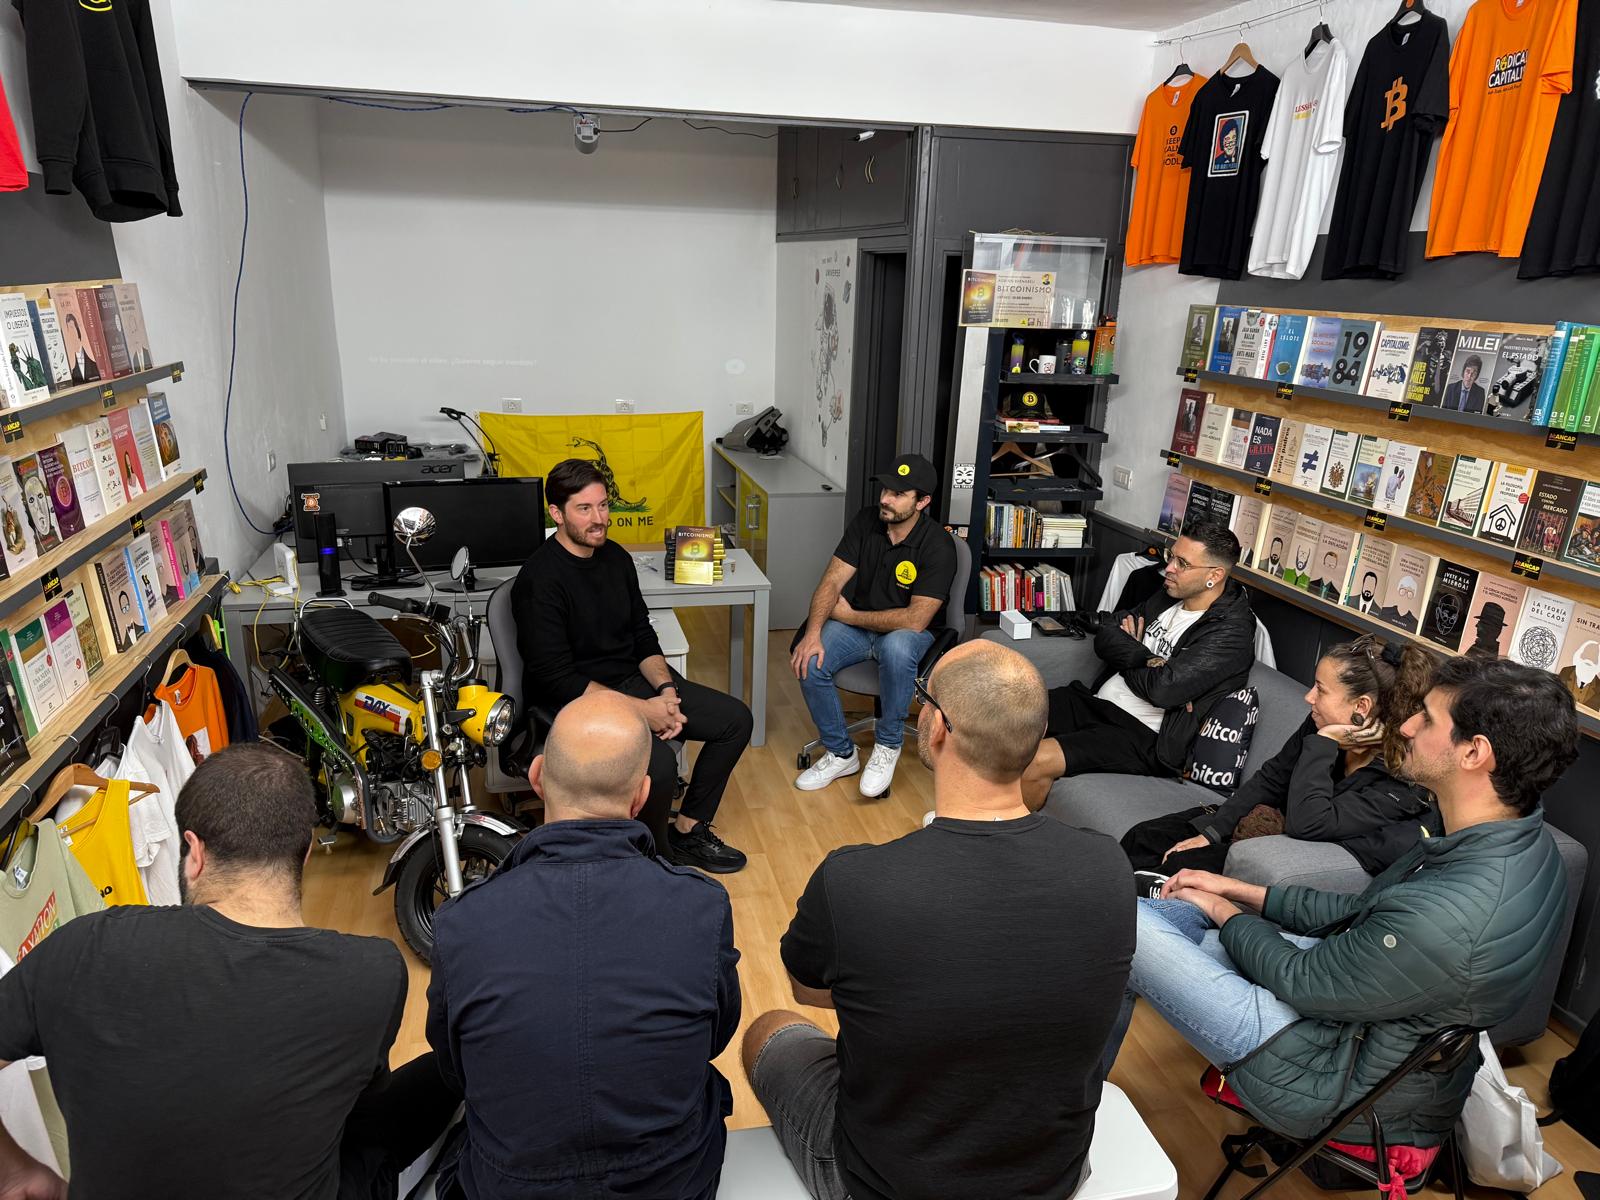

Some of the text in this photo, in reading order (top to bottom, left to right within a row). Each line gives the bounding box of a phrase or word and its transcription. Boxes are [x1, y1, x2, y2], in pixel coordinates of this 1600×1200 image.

[997, 285, 1052, 294] BITCOINISMO
[1344, 331, 1369, 358] 19
[1459, 335, 1500, 351] MILEI
[1511, 352, 1539, 361] ESTADO
[1332, 358, 1361, 386] 84
[1255, 425, 1273, 437] NADA
[1252, 435, 1262, 444] ES
[420, 464, 457, 474] acer
[1539, 491, 1558, 501] ESTADO
[1543, 504, 1568, 514] MERCADO
[617, 517, 632, 527] ON
[638, 516, 653, 526] ME
[678, 531, 714, 539] BITCOINISMO
[1442, 577, 1469, 591] MIERDA!
[1531, 607, 1565, 622] DEL CAOS
[1544, 604, 1567, 616] TEORÍA
[1577, 617, 1588, 626] SIN
[364, 695, 391, 717] DAX
